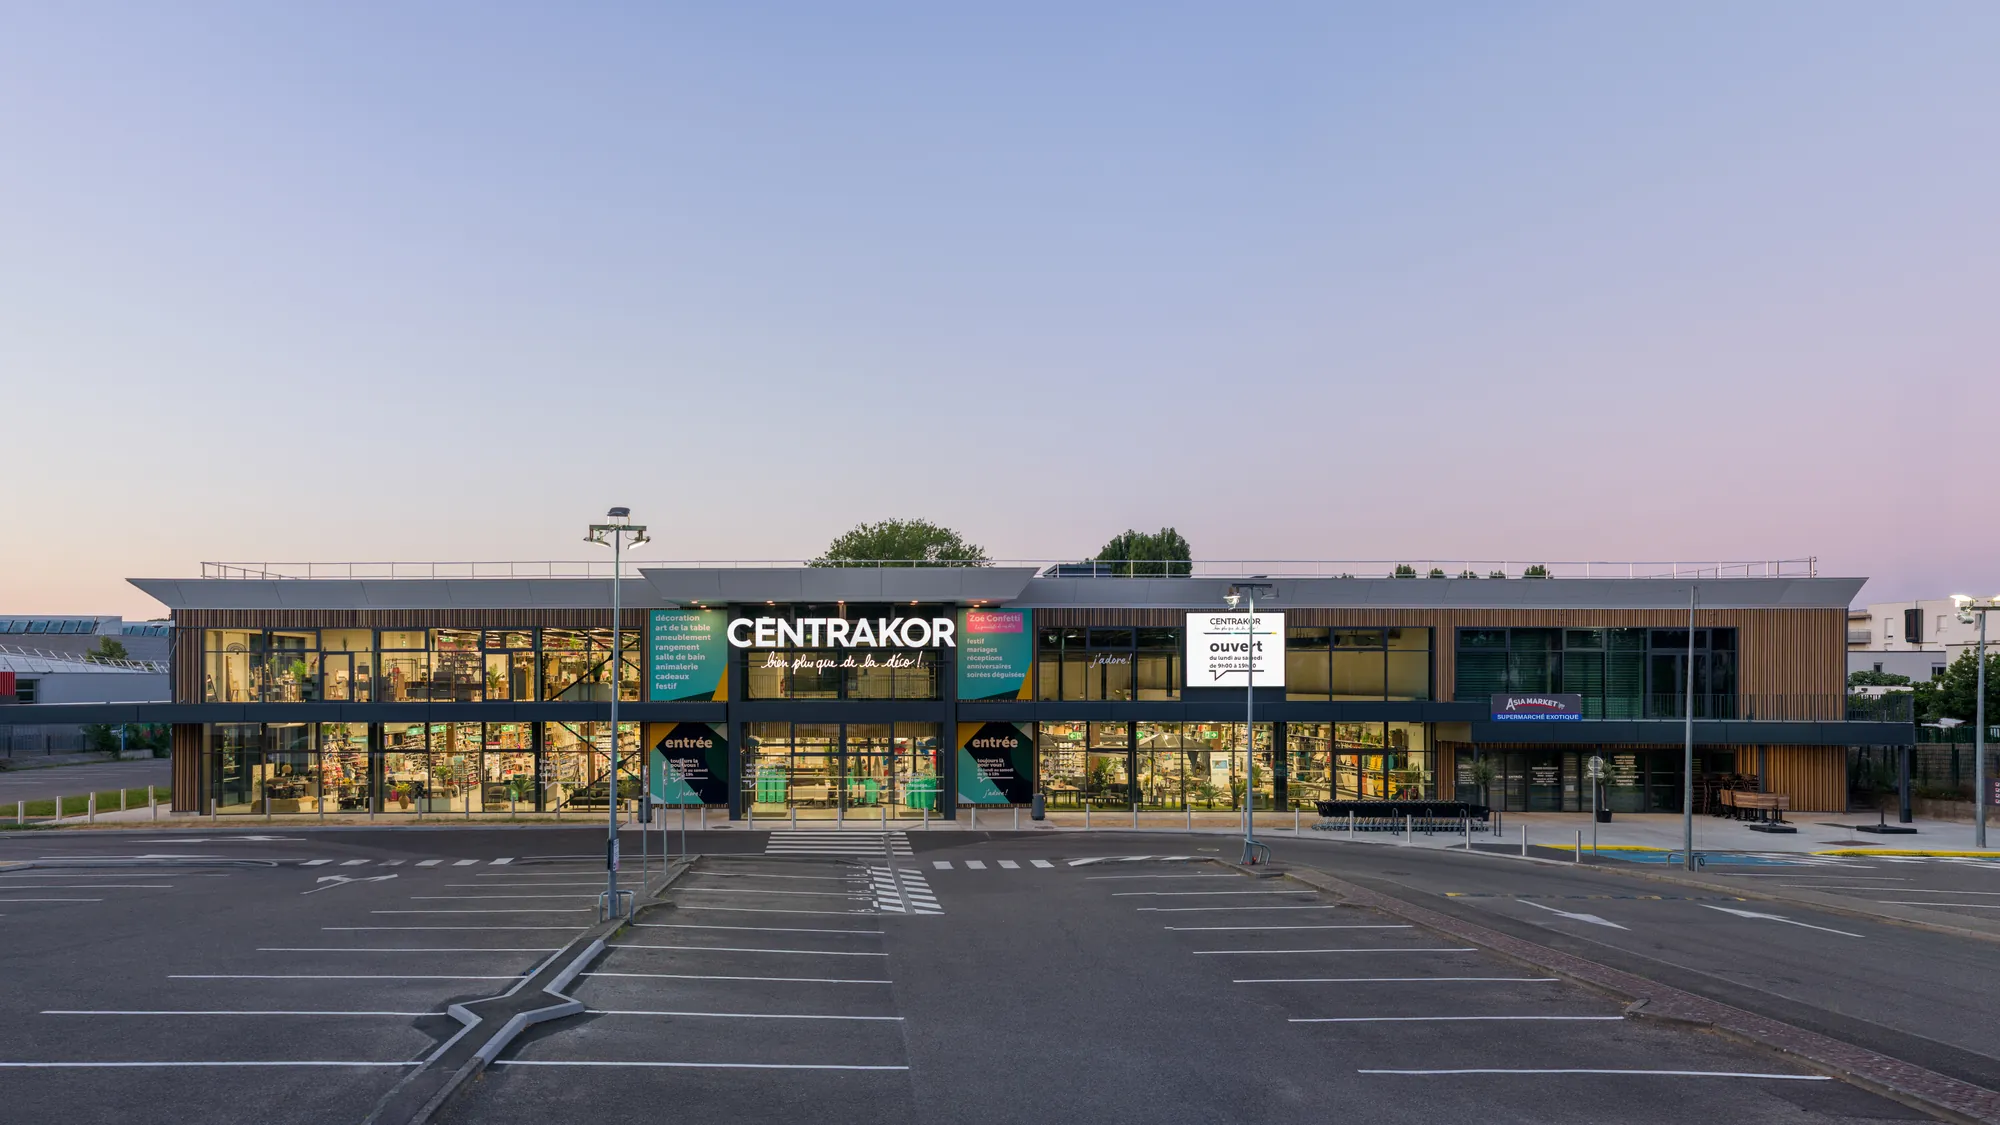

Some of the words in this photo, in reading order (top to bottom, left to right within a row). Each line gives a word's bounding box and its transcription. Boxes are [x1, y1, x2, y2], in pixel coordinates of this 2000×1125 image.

[655, 614, 700, 622] décoration
[969, 614, 985, 622] Zoé
[986, 614, 1021, 622] Confetti
[726, 617, 957, 648] CENTRAKOR
[655, 644, 700, 652] rangement
[761, 650, 789, 668] bien
[791, 653, 813, 675] plus
[816, 658, 837, 675] que
[839, 655, 858, 668] de
[859, 653, 880, 668] la
[881, 652, 916, 668] déco
[917, 650, 923, 668] !
[1526, 698, 1559, 707] MARKET
[665, 736, 713, 749] entrée
[972, 736, 1019, 748] entrée
[676, 789, 704, 799] jadore!
